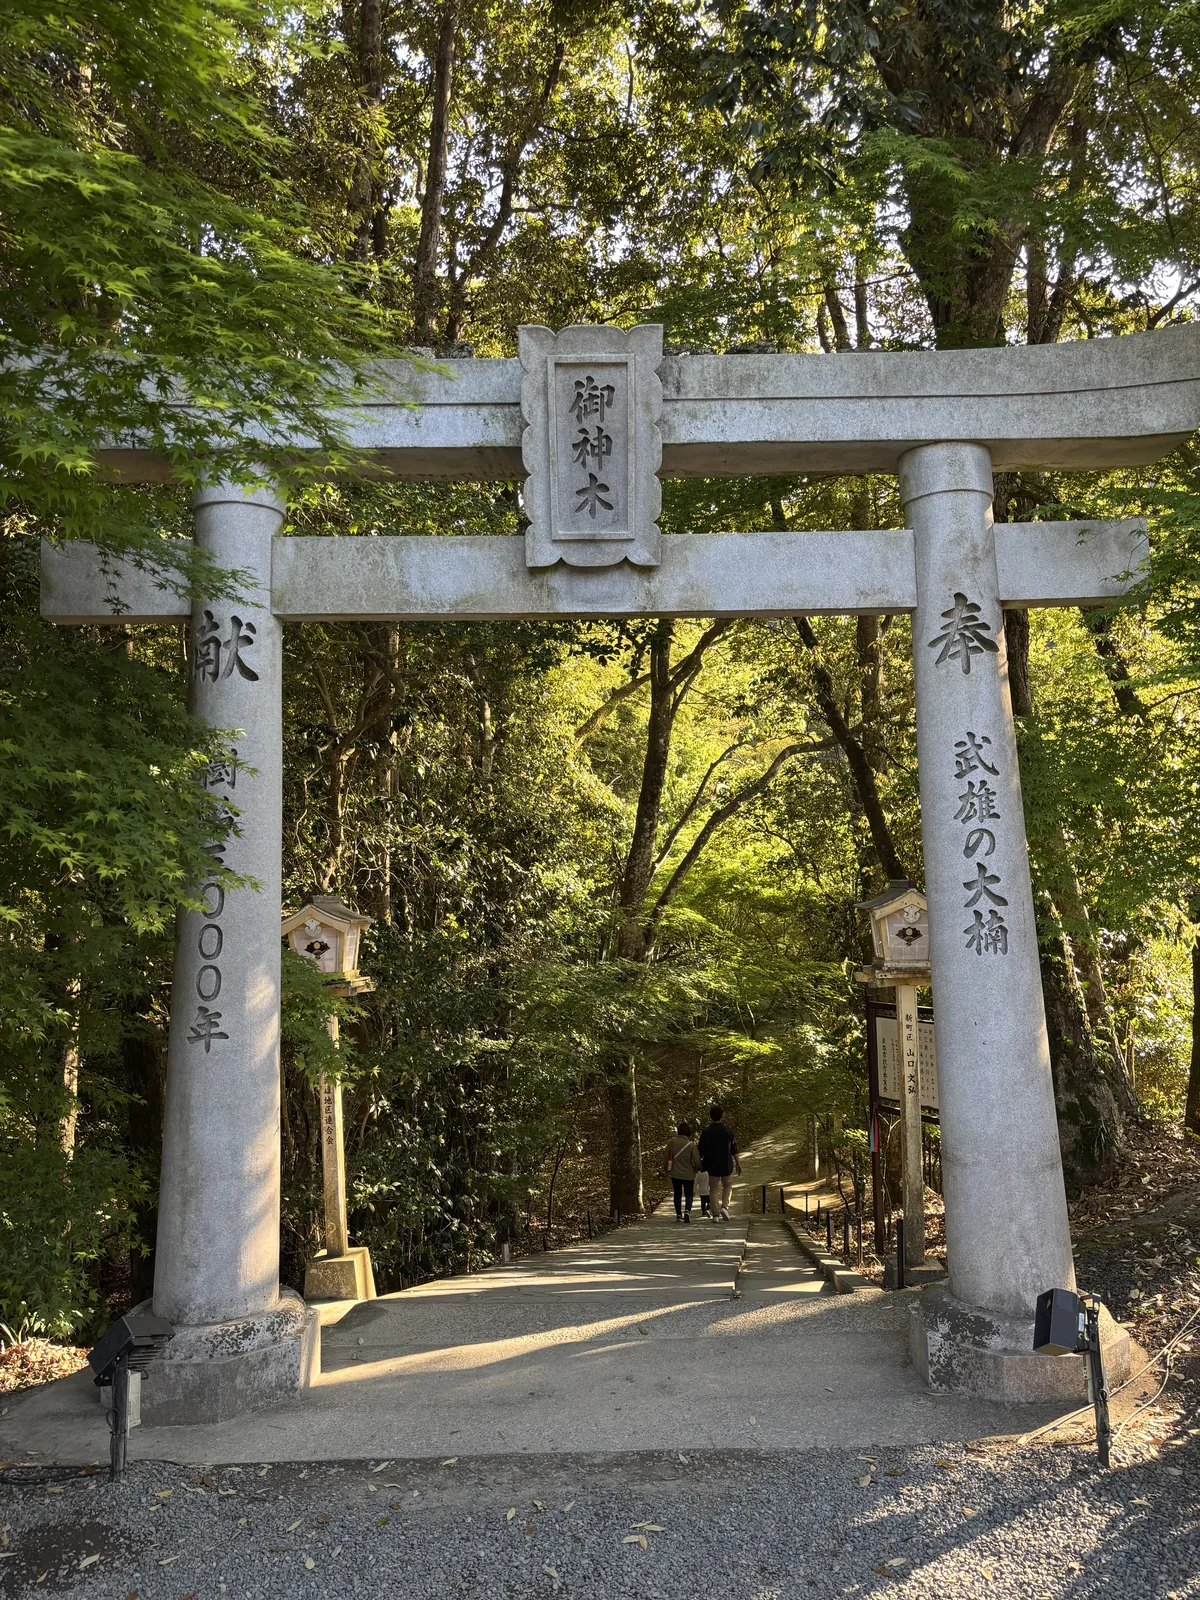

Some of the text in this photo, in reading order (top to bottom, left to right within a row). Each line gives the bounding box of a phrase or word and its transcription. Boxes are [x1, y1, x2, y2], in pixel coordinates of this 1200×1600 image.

[568, 375, 615, 519] 御神木
[193, 609, 260, 683] 献
[927, 591, 1009, 956] 奉 武雄の大楠
